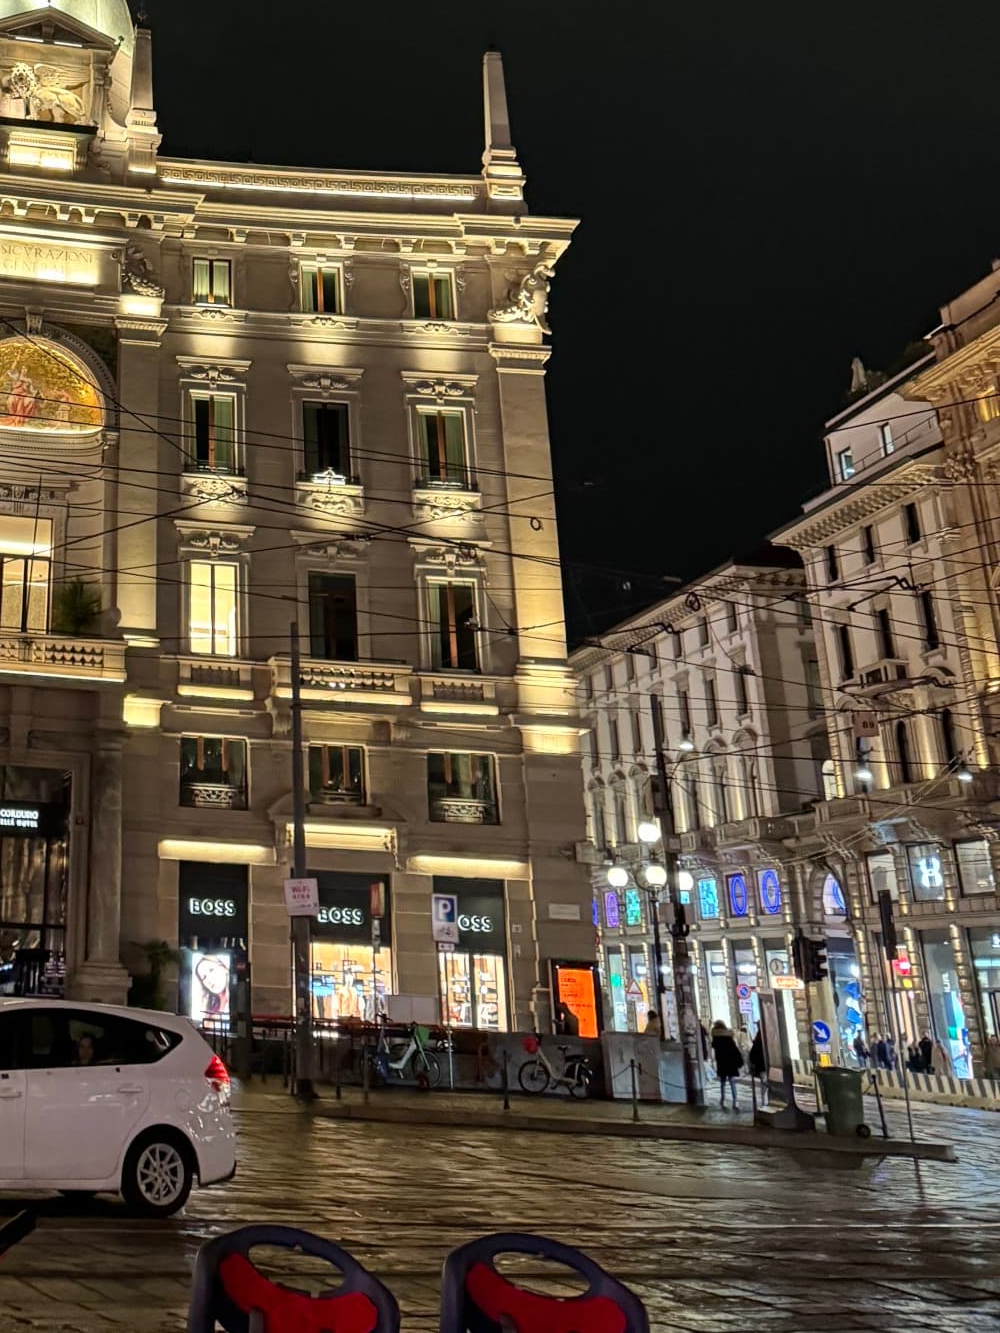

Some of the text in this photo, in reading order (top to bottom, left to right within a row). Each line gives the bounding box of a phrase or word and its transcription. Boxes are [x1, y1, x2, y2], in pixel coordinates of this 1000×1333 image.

[189, 897, 237, 916] BOSS
[439, 898, 451, 920] P
[317, 907, 365, 926] BOSS
[457, 914, 493, 932] OSS
